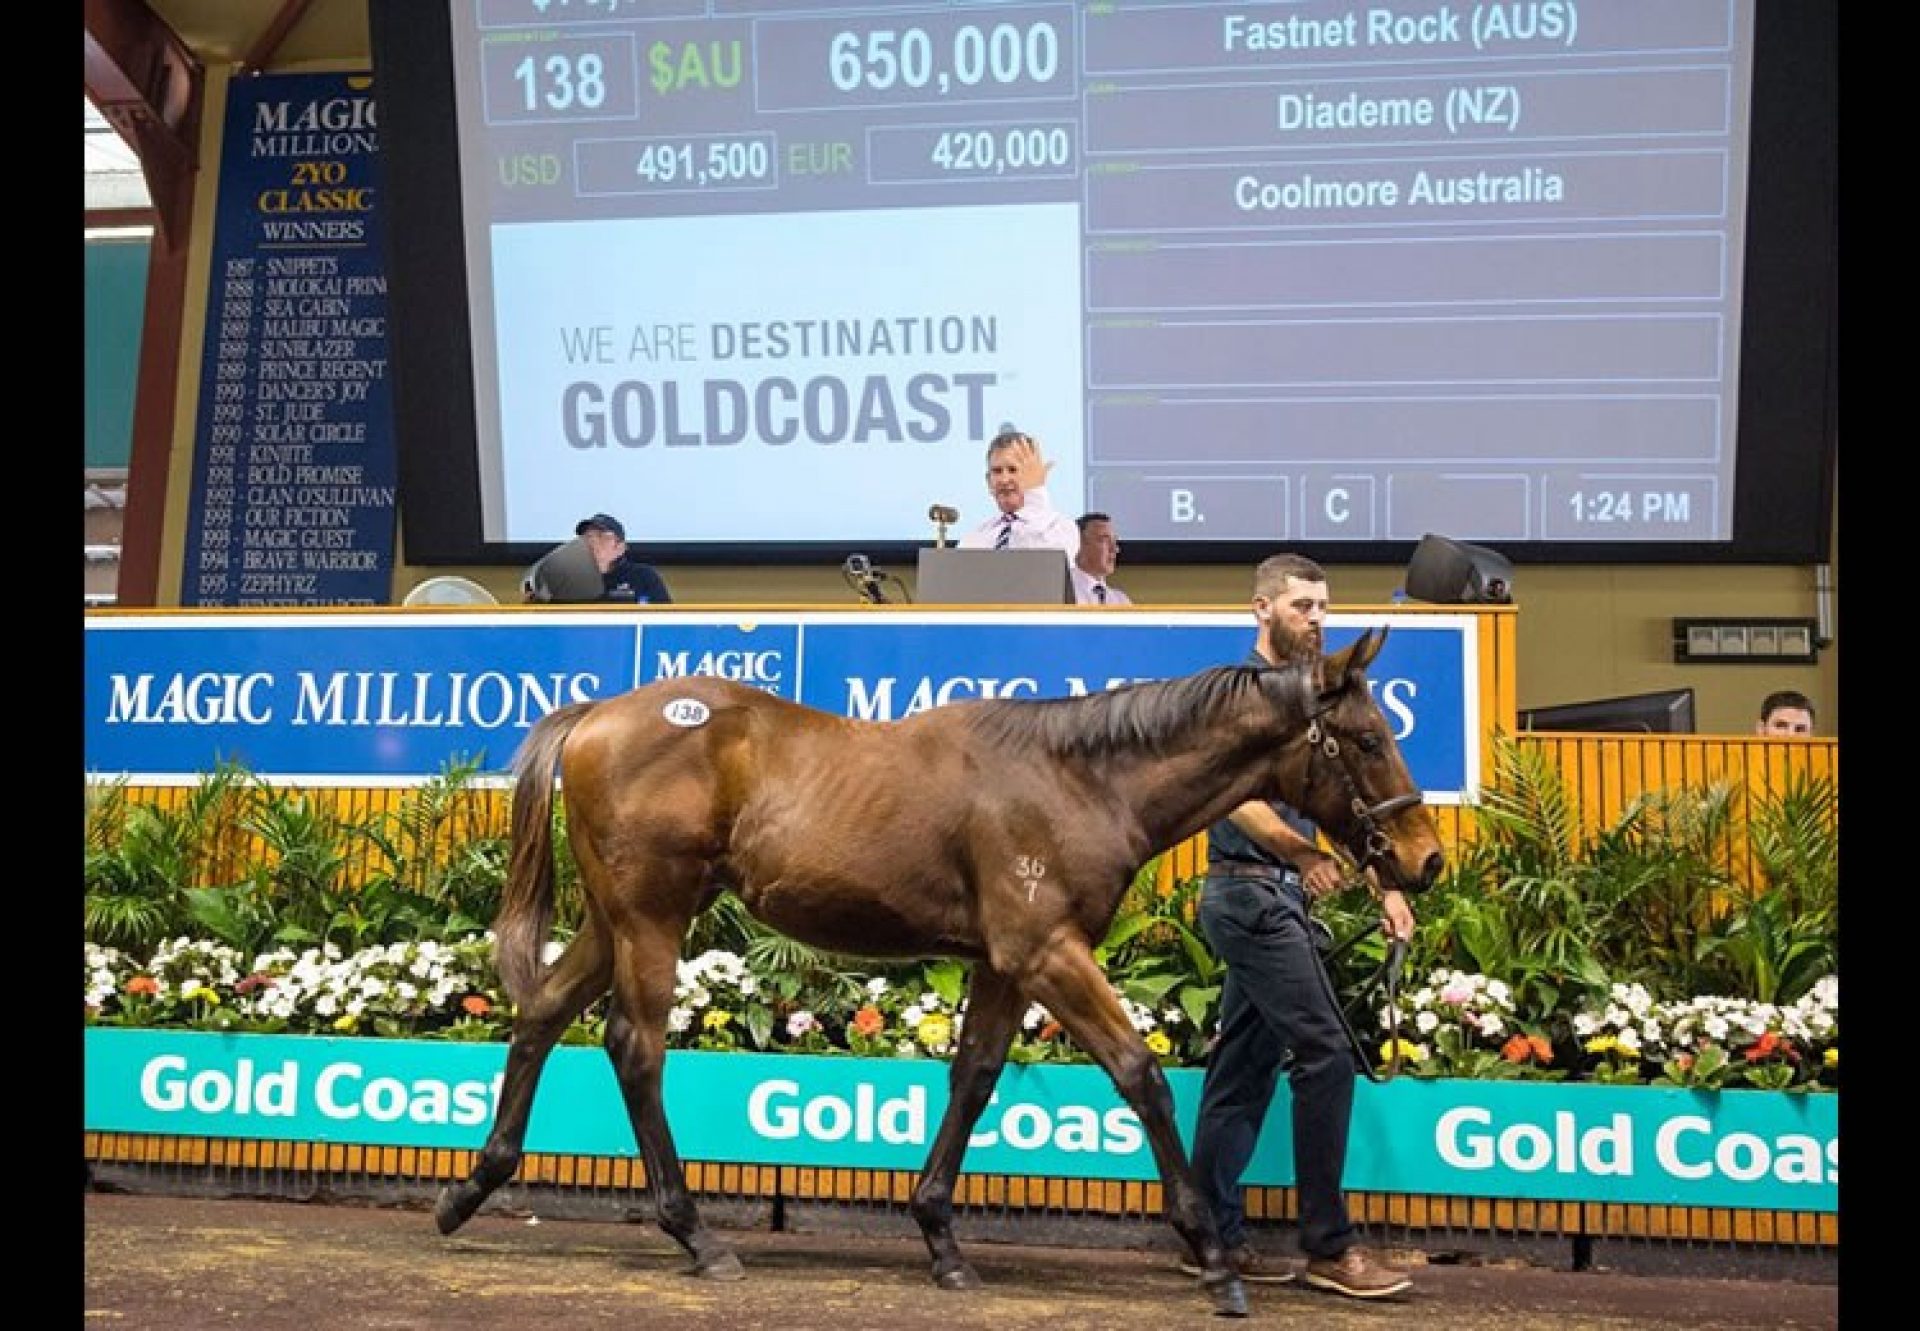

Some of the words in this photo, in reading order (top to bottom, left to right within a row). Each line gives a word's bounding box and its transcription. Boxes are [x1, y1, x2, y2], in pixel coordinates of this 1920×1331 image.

[1224, 14, 1356, 51] Fastnet
[1367, 10, 1460, 46] Rock
[1470, 1, 1579, 49] (AUS)
[648, 40, 743, 94] $AU
[829, 21, 1059, 95] 650,000
[514, 53, 606, 111] 138
[1278, 92, 1434, 130] Diademe
[1445, 87, 1521, 133] (NZ)
[251, 132, 379, 157] MILLION
[931, 128, 1070, 174] 420,000
[291, 160, 347, 185] 2YO
[499, 154, 561, 188] USD
[637, 142, 768, 185] 491,500
[789, 143, 854, 175] EUR
[257, 188, 375, 214] CLASSIC
[1236, 175, 1398, 210] Coolmore
[1408, 167, 1564, 206] Australia
[263, 219, 365, 240] WINNERS
[266, 257, 338, 276] SNIPPETS
[265, 278, 341, 297] MOLOKAI
[264, 299, 294, 318] SEA
[299, 299, 351, 317] CABIN
[263, 319, 327, 338] MALIBU
[331, 317, 385, 337] MAGIC
[561, 326, 615, 363] WE
[629, 324, 698, 362] ARE
[712, 316, 998, 360] DESTINATION
[260, 339, 356, 358] SUNBLAZER
[258, 361, 317, 379] PRINCE
[320, 360, 387, 379] REGENT
[340, 381, 370, 404] JOY
[255, 403, 279, 422] ST.
[283, 402, 326, 424] JUDE
[253, 424, 305, 443] SOLAR
[309, 423, 366, 443] CIRCLE
[248, 466, 292, 484] BOLD
[295, 466, 364, 484] PROMISE
[247, 487, 294, 505] CLAN
[1171, 489, 1205, 522] B.
[1324, 487, 1350, 521] C
[1569, 491, 1634, 522] 1:24
[1642, 491, 1691, 521] PM
[245, 508, 280, 526] OUR
[284, 507, 349, 526] FICTION
[243, 529, 297, 548] MAGIC
[302, 529, 356, 548] GUEST
[243, 551, 298, 569] BRAVE
[304, 551, 378, 570] WARRIOR
[655, 649, 783, 682] MAGIC
[106, 672, 274, 725] MAGIC
[671, 702, 706, 722] 138
[140, 1054, 298, 1117] Gold
[747, 1079, 927, 1145] Gold
[1434, 1106, 1635, 1177] Gold
